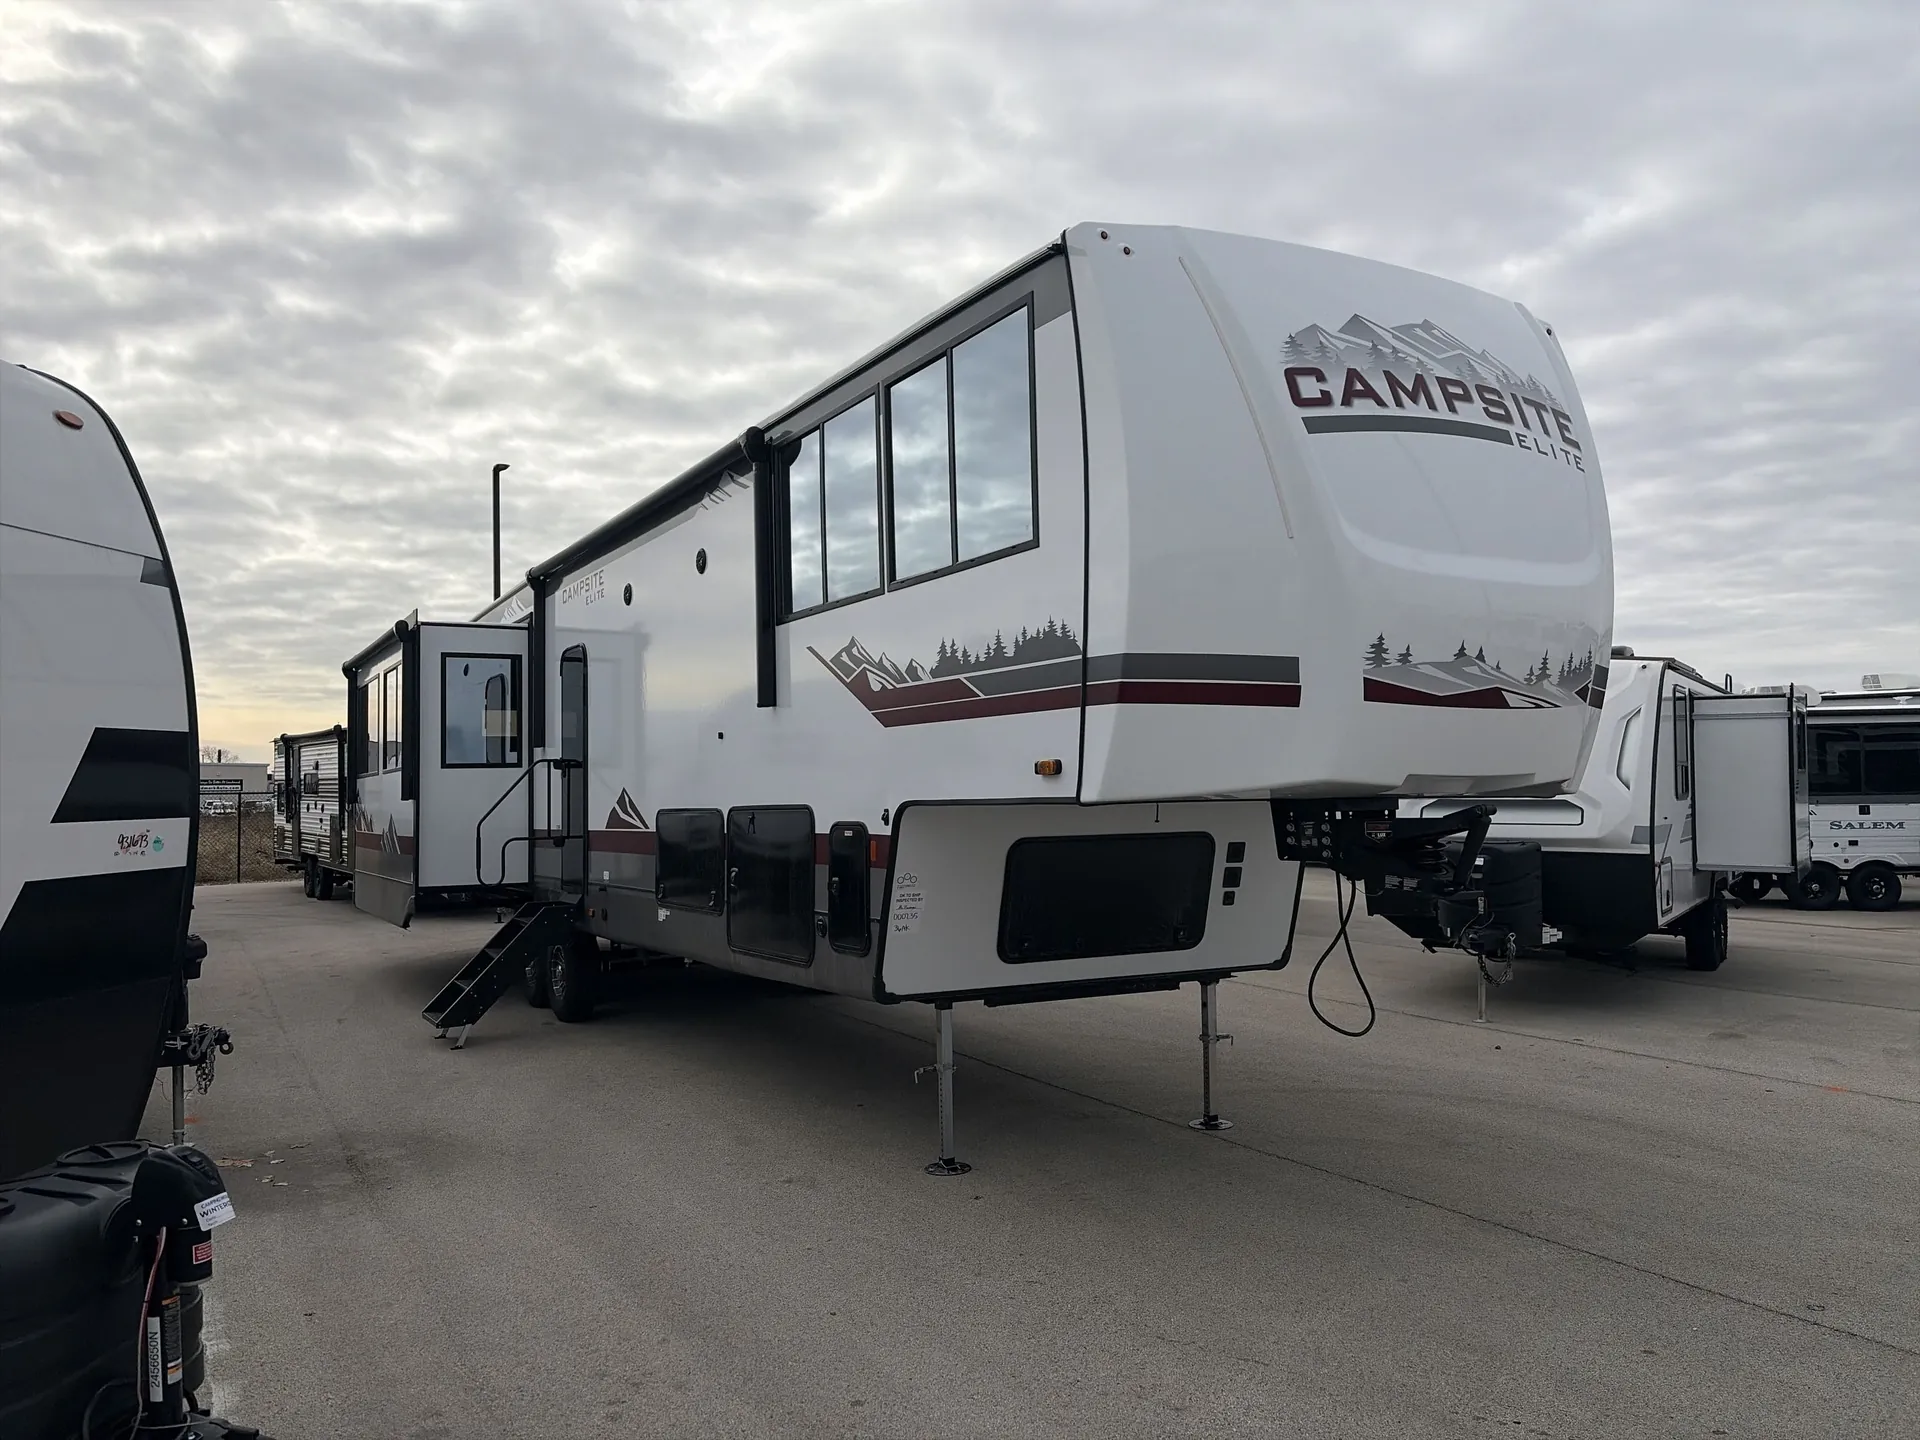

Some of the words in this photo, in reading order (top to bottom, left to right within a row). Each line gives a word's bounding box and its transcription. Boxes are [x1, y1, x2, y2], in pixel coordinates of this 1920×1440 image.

[1283, 366, 1582, 450] CAMPSITE
[1514, 432, 1586, 473] ELITE
[562, 569, 604, 605] CAMPSITE
[585, 588, 604, 605] ELITE
[1829, 820, 1906, 830] SALEM
